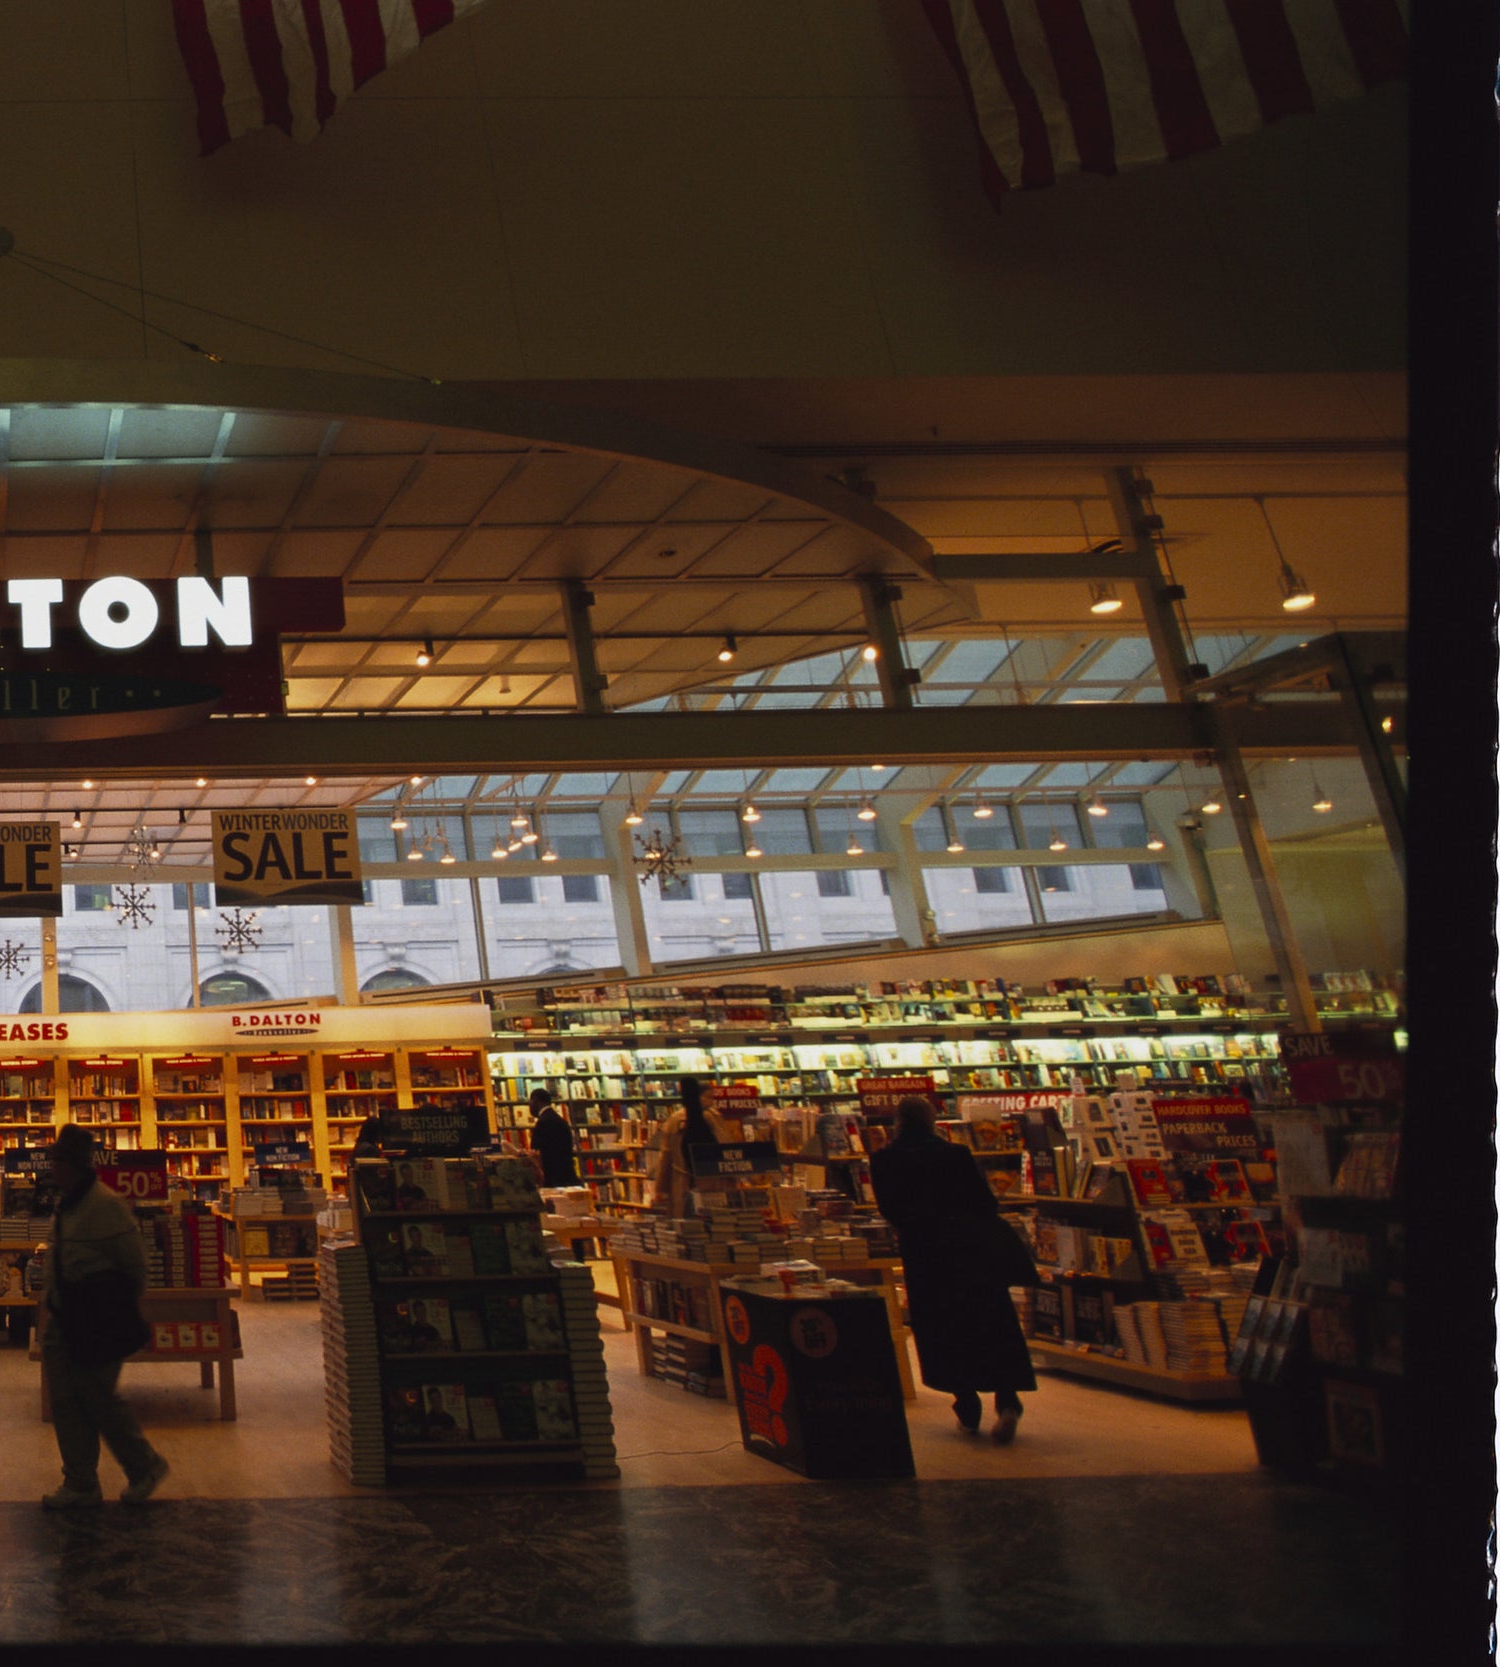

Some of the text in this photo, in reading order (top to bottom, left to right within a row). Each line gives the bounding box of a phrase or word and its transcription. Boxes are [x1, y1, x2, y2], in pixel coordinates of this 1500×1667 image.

[222, 832, 353, 882] SALE
[250, 1013, 321, 1026] DALTON
[1284, 1035, 1334, 1057] SAVE
[863, 1094, 888, 1106] GIFT
[1156, 1104, 1246, 1115] HARDCOVER BOOKS
[400, 1115, 468, 1130] BESTSELLING
[1161, 1121, 1227, 1136] PAPERBACK
[412, 1130, 460, 1144] AUTHORS
[1216, 1135, 1257, 1148] PRICES
[30, 1152, 46, 1160] NEW
[92, 1150, 119, 1166] AVE
[722, 1150, 744, 1160] NEW
[718, 1161, 755, 1173] FICTION
